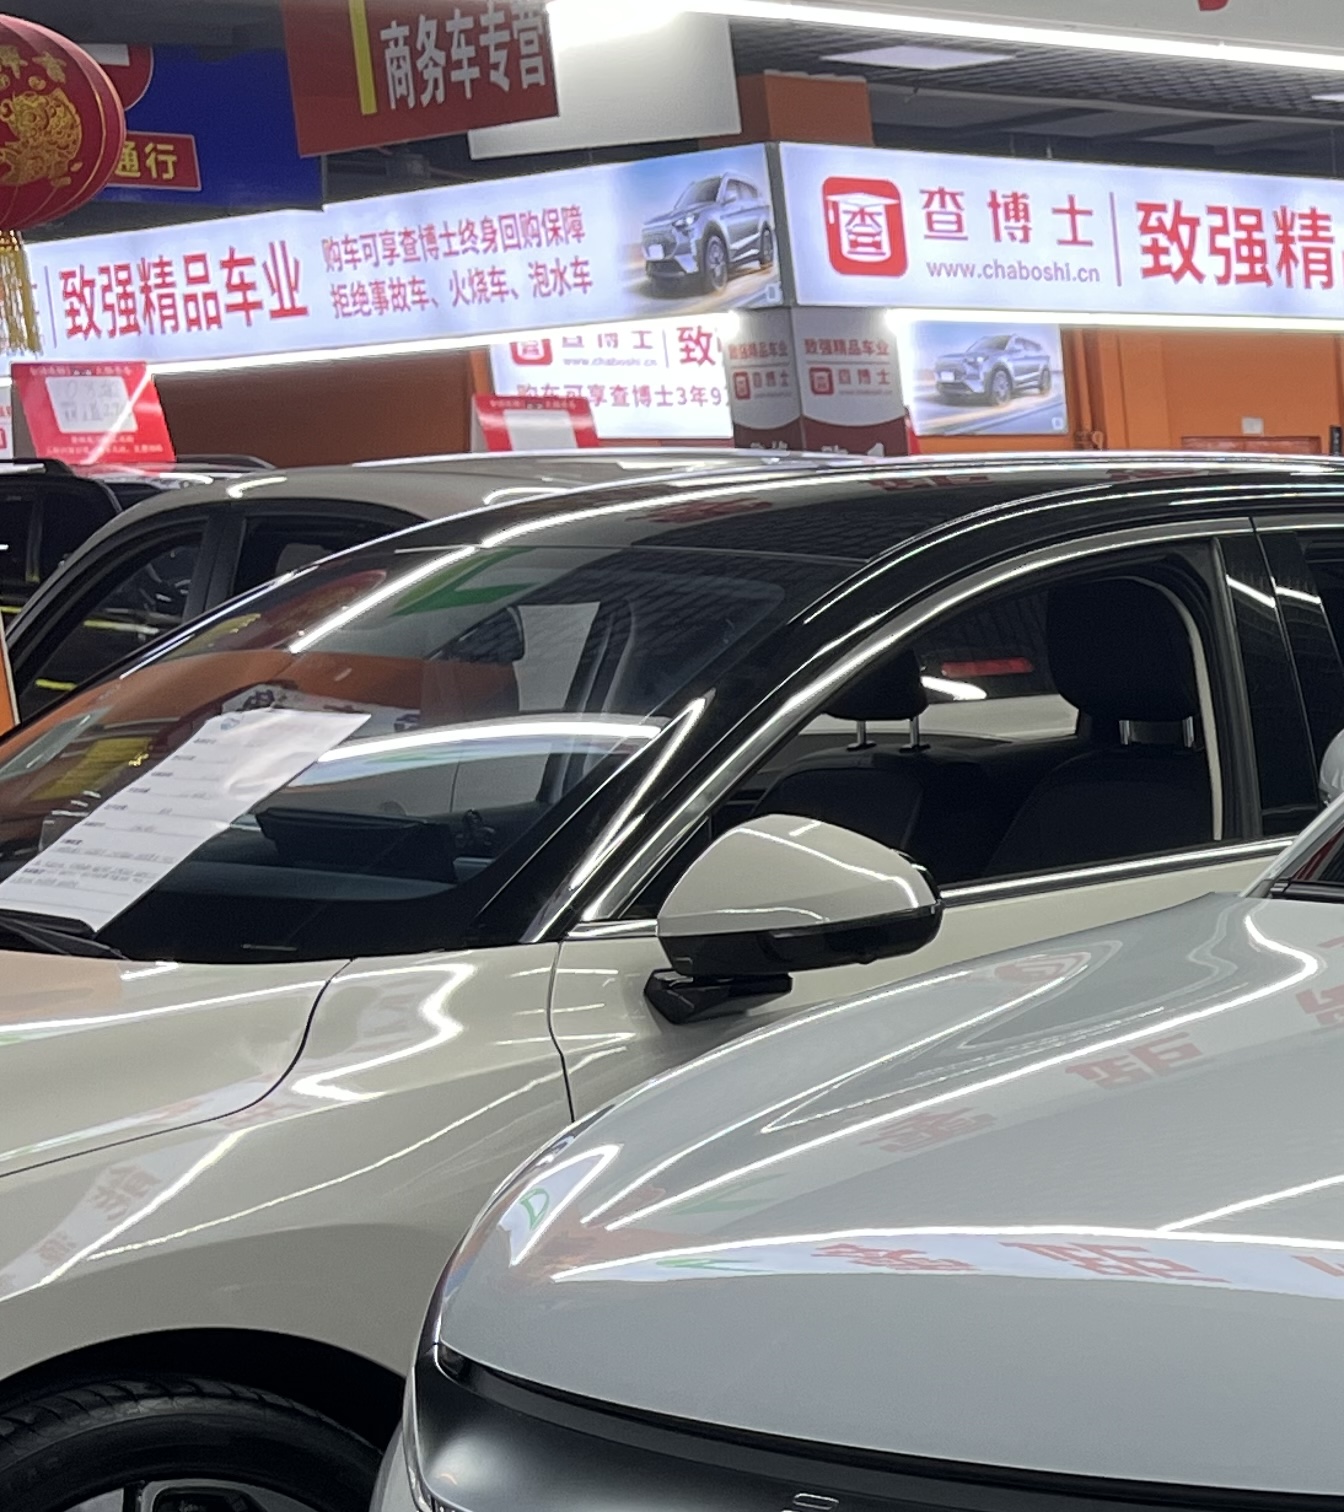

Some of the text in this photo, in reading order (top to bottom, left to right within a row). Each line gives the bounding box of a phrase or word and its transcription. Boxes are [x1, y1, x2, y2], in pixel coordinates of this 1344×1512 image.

[380, 0, 546, 109] 商务车专营
[322, 204, 585, 273] 购车可享查博士终身回购保障
[919, 185, 1094, 247] 查博士
[59, 240, 309, 342] 致强精品车业
[926, 258, 1100, 283] www.chaboshi.cn
